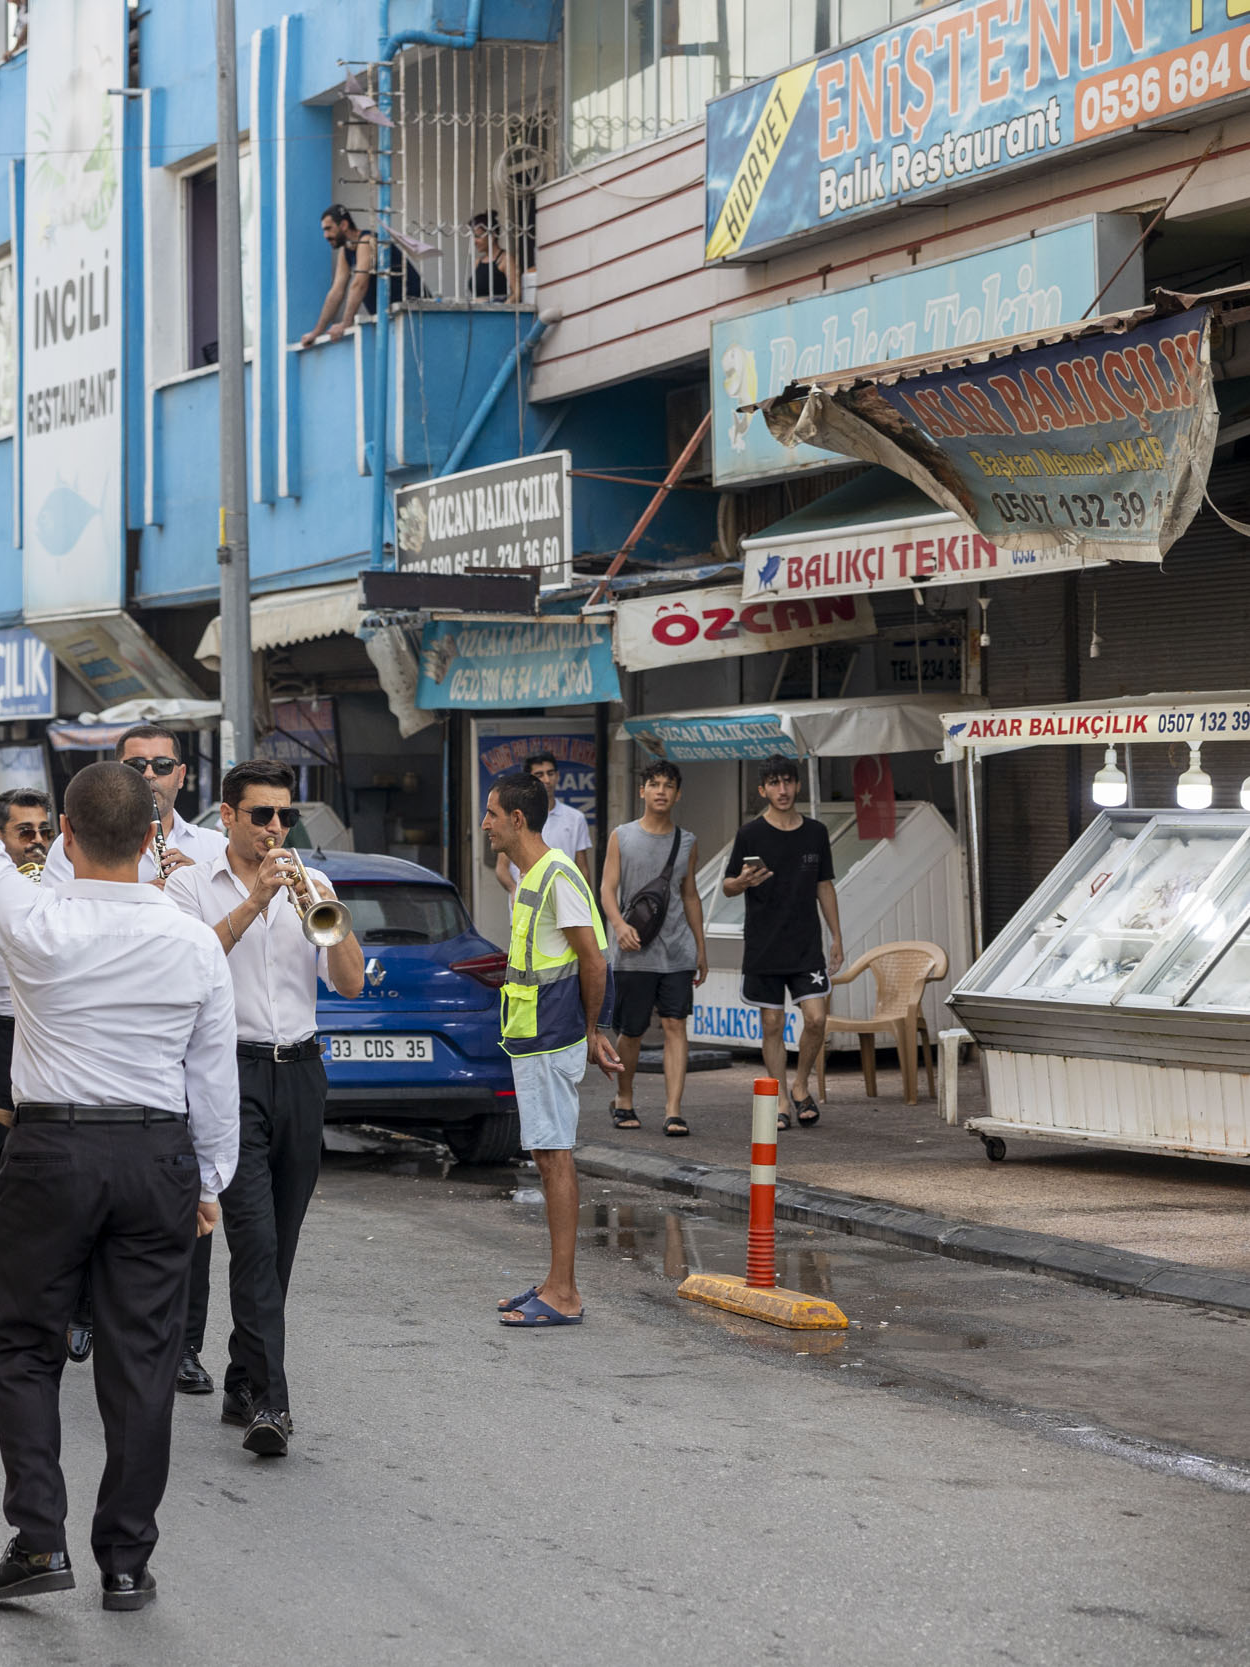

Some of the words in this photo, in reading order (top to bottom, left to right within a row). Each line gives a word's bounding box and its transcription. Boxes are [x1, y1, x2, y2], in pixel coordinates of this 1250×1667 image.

[1081, 67, 1161, 131] 0536
[1168, 43, 1231, 104] 684
[724, 87, 790, 243] HİDAYET
[818, 152, 885, 218] Balık
[890, 95, 1062, 196] Restaurant
[34, 248, 109, 351] İNCİLİ
[924, 263, 1062, 352] Tekin
[27, 368, 116, 437] RESTAURANT
[900, 382, 1015, 437] AKAR
[988, 330, 1200, 434] BALIKÇILIK
[970, 449, 1038, 484] Başkan
[1037, 447, 1108, 477] Mehmet
[1107, 436, 1167, 474] AKAR
[428, 486, 475, 541] ÖZCAN
[475, 472, 560, 537] BALIKÇILIK
[991, 491, 1054, 525] 0507
[1059, 491, 1110, 528] 132
[1113, 491, 1146, 528] 39
[543, 536, 559, 573] 60
[787, 547, 885, 591] BALIKÇI
[892, 533, 998, 579] TEKİN
[457, 623, 510, 657] ÖZCAN
[652, 595, 857, 646] ÖZCAN
[653, 722, 701, 742] ÖZCAN
[700, 722, 782, 744] BALIKÇILIK
[967, 719, 1023, 738] AKAR
[1028, 714, 1149, 739] BALIKÇILIK
[1158, 713, 1194, 733] 0507
[1200, 711, 1227, 732] 132
[1231, 711, 1250, 731] 39
[332, 1040, 351, 1058] 33
[364, 1040, 394, 1058] CDS
[406, 1040, 426, 1058] 35
